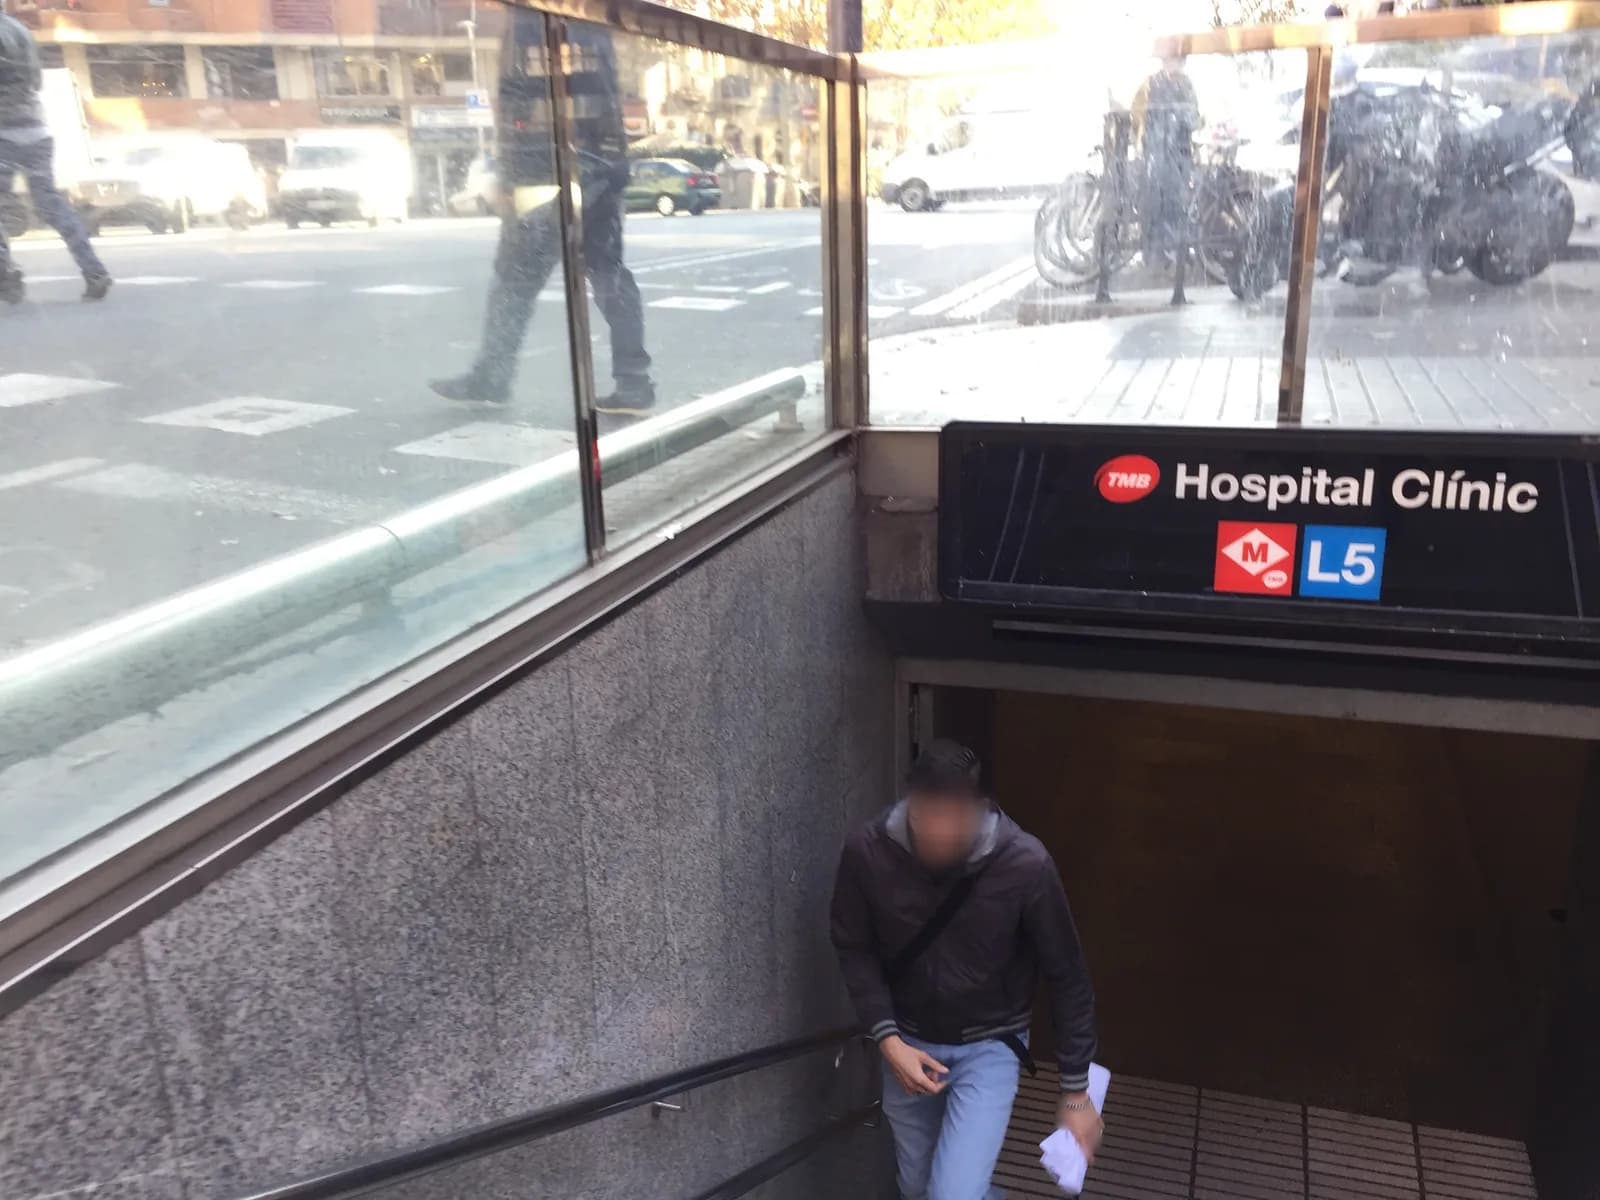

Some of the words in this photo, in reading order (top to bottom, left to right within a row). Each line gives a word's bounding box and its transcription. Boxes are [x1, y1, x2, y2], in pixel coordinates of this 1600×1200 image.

[1107, 471, 1152, 490] TMB
[1174, 463, 1376, 512] Hospital
[1391, 468, 1540, 514] Clínic
[1241, 541, 1269, 563] M
[1306, 539, 1376, 586] L5
